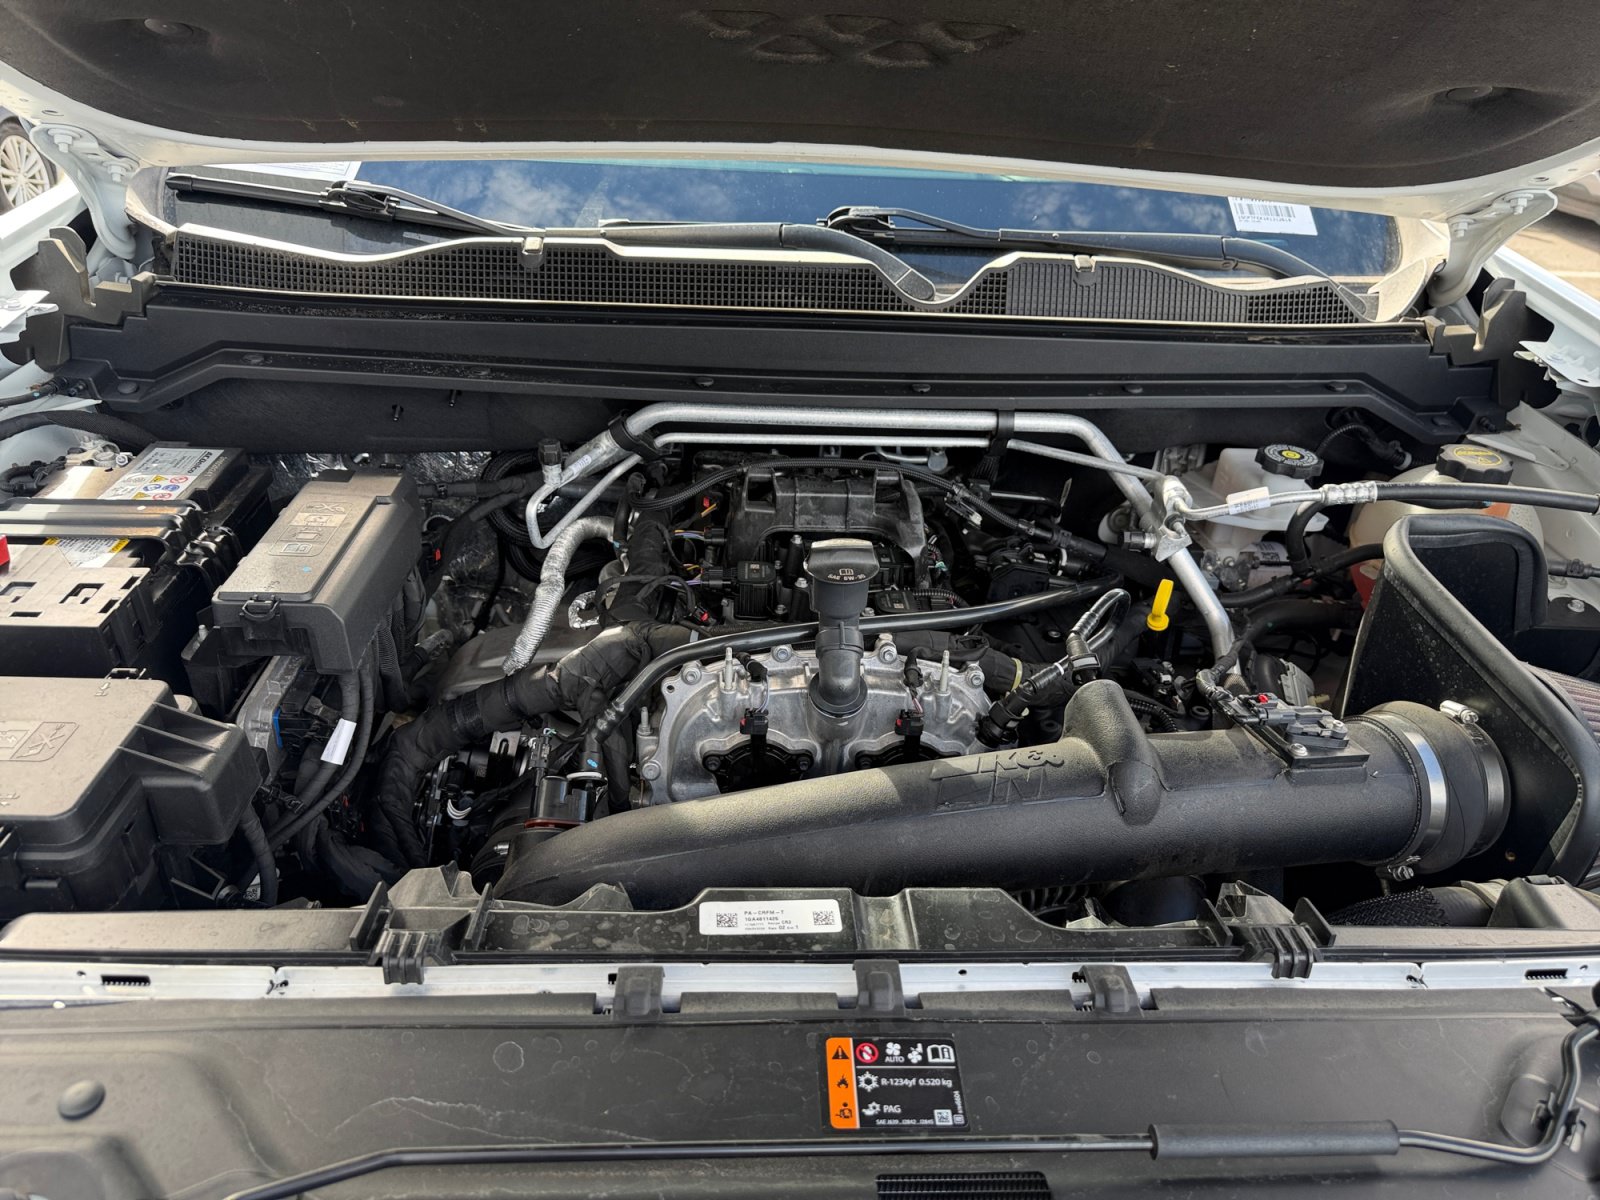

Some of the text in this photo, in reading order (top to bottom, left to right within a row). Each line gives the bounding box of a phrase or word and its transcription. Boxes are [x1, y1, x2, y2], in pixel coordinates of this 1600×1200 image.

[188, 451, 213, 474] ACDelco
[881, 1078, 952, 1088] R-1234yf 0.520 kg
[883, 1105, 901, 1113] PAG
